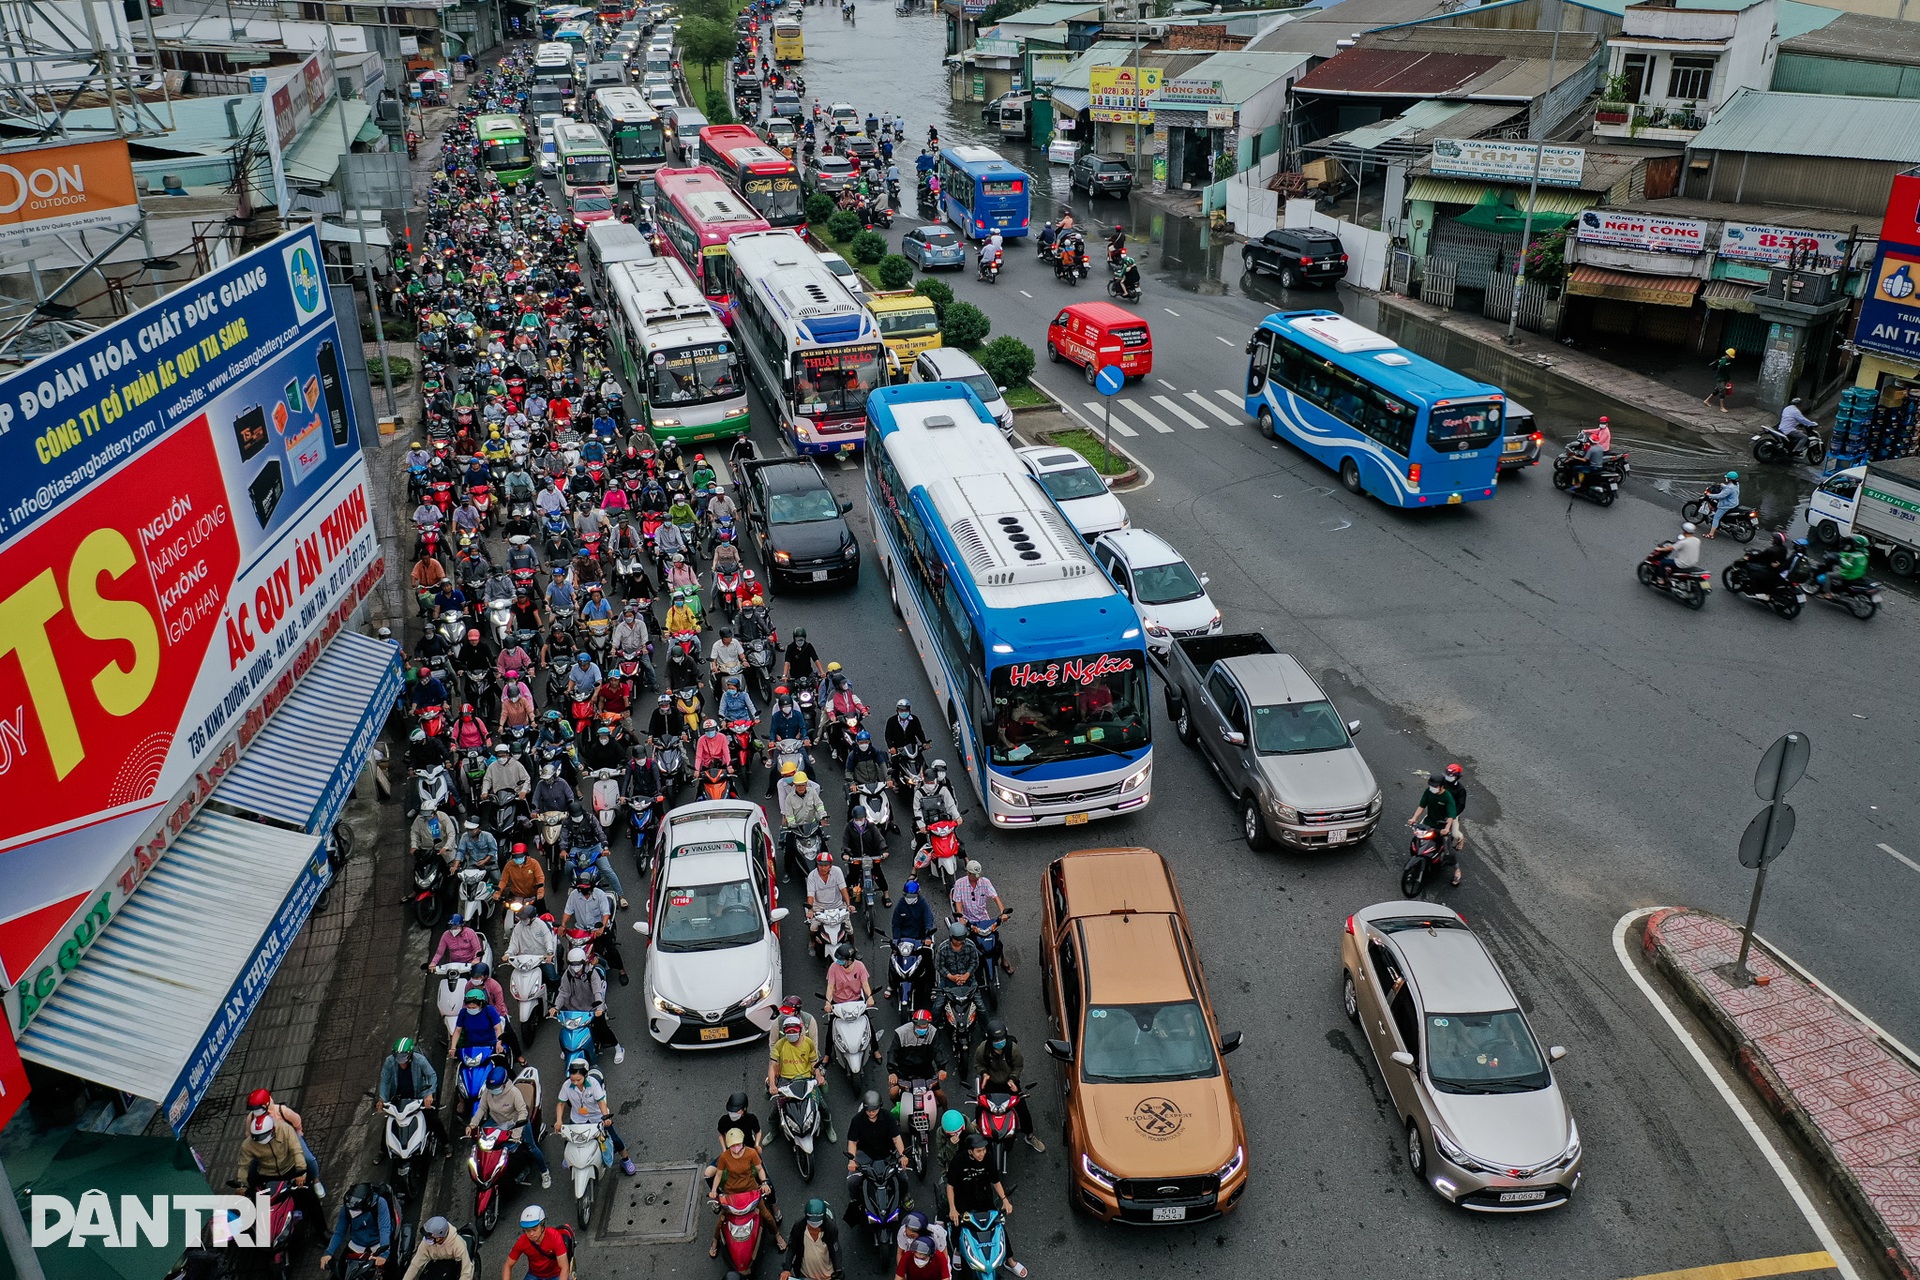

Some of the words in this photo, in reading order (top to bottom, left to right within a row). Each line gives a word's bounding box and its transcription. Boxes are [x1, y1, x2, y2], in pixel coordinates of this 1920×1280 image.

[30, 194, 87, 210] OUTDOOR
[1649, 225, 1699, 238] CÔNG
[1745, 226, 1771, 235] CÔNG
[1773, 228, 1787, 236] TY
[1789, 230, 1814, 238] TNHH
[1816, 232, 1838, 241] MTV
[19, 362, 89, 421] ĐOÀN
[89, 338, 138, 382] HÓA
[138, 308, 183, 354] CHẤT
[183, 292, 219, 329] ĐỨC
[219, 265, 268, 308] GIANG
[679, 350, 691, 360] XE
[692, 347, 714, 358] BUÝT
[1871, 322, 1900, 341] AN
[667, 359, 684, 368] LONG
[684, 358, 693, 366] AN
[802, 355, 840, 369] THUẬN
[842, 352, 874, 364] THẢO
[35, 418, 82, 465] CÔNG
[78, 404, 101, 437] TY
[99, 383, 124, 425] CỔ
[121, 368, 160, 413] PHẦN
[157, 357, 179, 391] ẮC
[175, 344, 202, 380] QUY
[199, 333, 222, 363] TIA
[218, 316, 249, 351] SÁNG
[8, 418, 158, 526] info@tiasangbattery.com
[167, 385, 208, 421] website:
[206, 323, 301, 393] www.tiasangbattery.com
[141, 494, 193, 547] NGUỒN
[151, 536, 189, 581] NĂNG
[187, 503, 226, 549] LƯỢNG
[161, 559, 209, 613] KHÔNG
[223, 600, 257, 672] ẮC
[254, 557, 295, 636] QUY
[294, 536, 323, 598] ÂN
[319, 482, 369, 564] THỊNH
[170, 606, 196, 643] GIỚI
[194, 583, 220, 620] HẠN
[187, 725, 207, 760] 736
[203, 702, 227, 742] KINH
[222, 675, 252, 720] DƯƠNG
[247, 648, 275, 691] VƯƠNG
[275, 632, 288, 660] AN
[285, 619, 300, 650] LẠC
[299, 600, 318, 631] BÌNH
[314, 585, 329, 613] TÂN
[1009, 664, 1060, 687] Huệ
[1061, 653, 1134, 686] Nghĩa
[691, 843, 722, 853] VINASUN
[18, 965, 57, 1031] ẮC
[57, 891, 112, 975] QUY
[115, 827, 167, 897] TÂN
[224, 987, 246, 1032] ÂN
[242, 929, 282, 997] THỊNH
[1124, 1113, 1154, 1122] TOOLS
